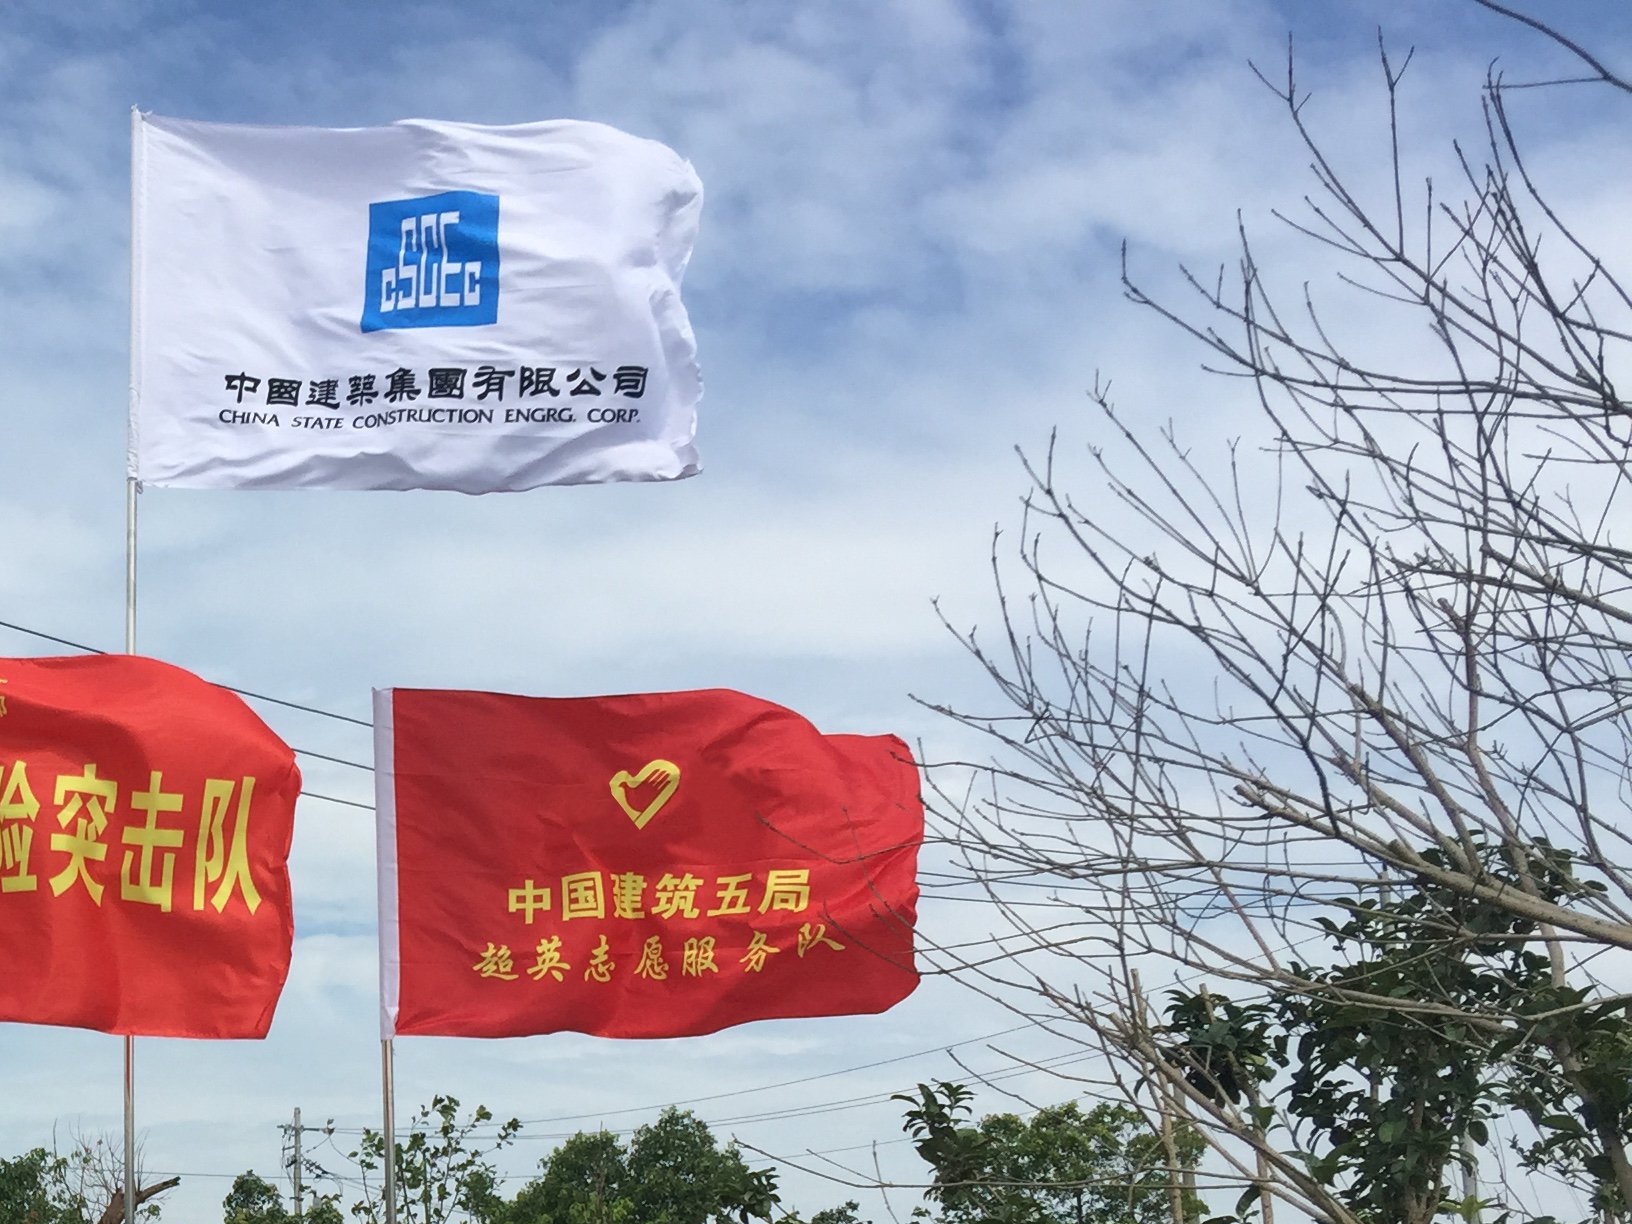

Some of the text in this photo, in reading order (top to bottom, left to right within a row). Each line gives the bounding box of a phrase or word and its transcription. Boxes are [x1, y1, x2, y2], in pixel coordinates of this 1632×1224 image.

[225, 366, 649, 408] 中國建築集團有限公司
[218, 408, 641, 430] CHINA STATE CONSTRUCTION ENGRG. CORP.
[507, 868, 811, 925] 中国建筑五局
[472, 922, 846, 983] 超英志愿服务队
